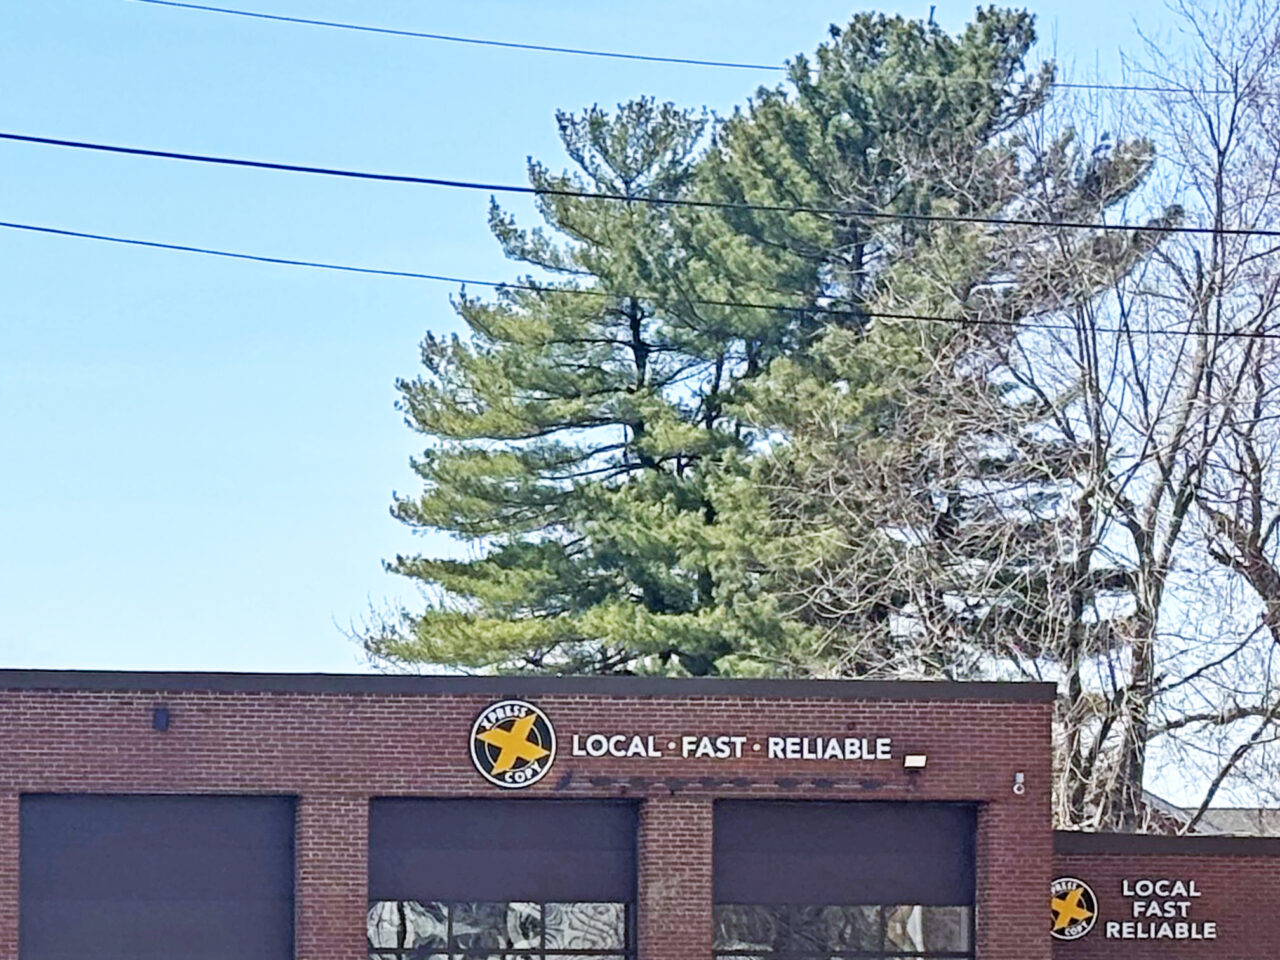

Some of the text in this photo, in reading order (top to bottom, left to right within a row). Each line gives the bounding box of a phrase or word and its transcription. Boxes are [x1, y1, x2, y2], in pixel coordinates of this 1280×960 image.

[481, 705, 528, 730] XPRESS
[572, 734, 892, 760] LOCAL FAST RELIABLE
[504, 761, 541, 783] COPY
[1051, 881, 1078, 895] PRESS
[1123, 879, 1202, 897] LOCAL
[1133, 901, 1191, 918] FAST
[1064, 920, 1088, 936] COPY
[1106, 921, 1217, 939] RELIABLE
